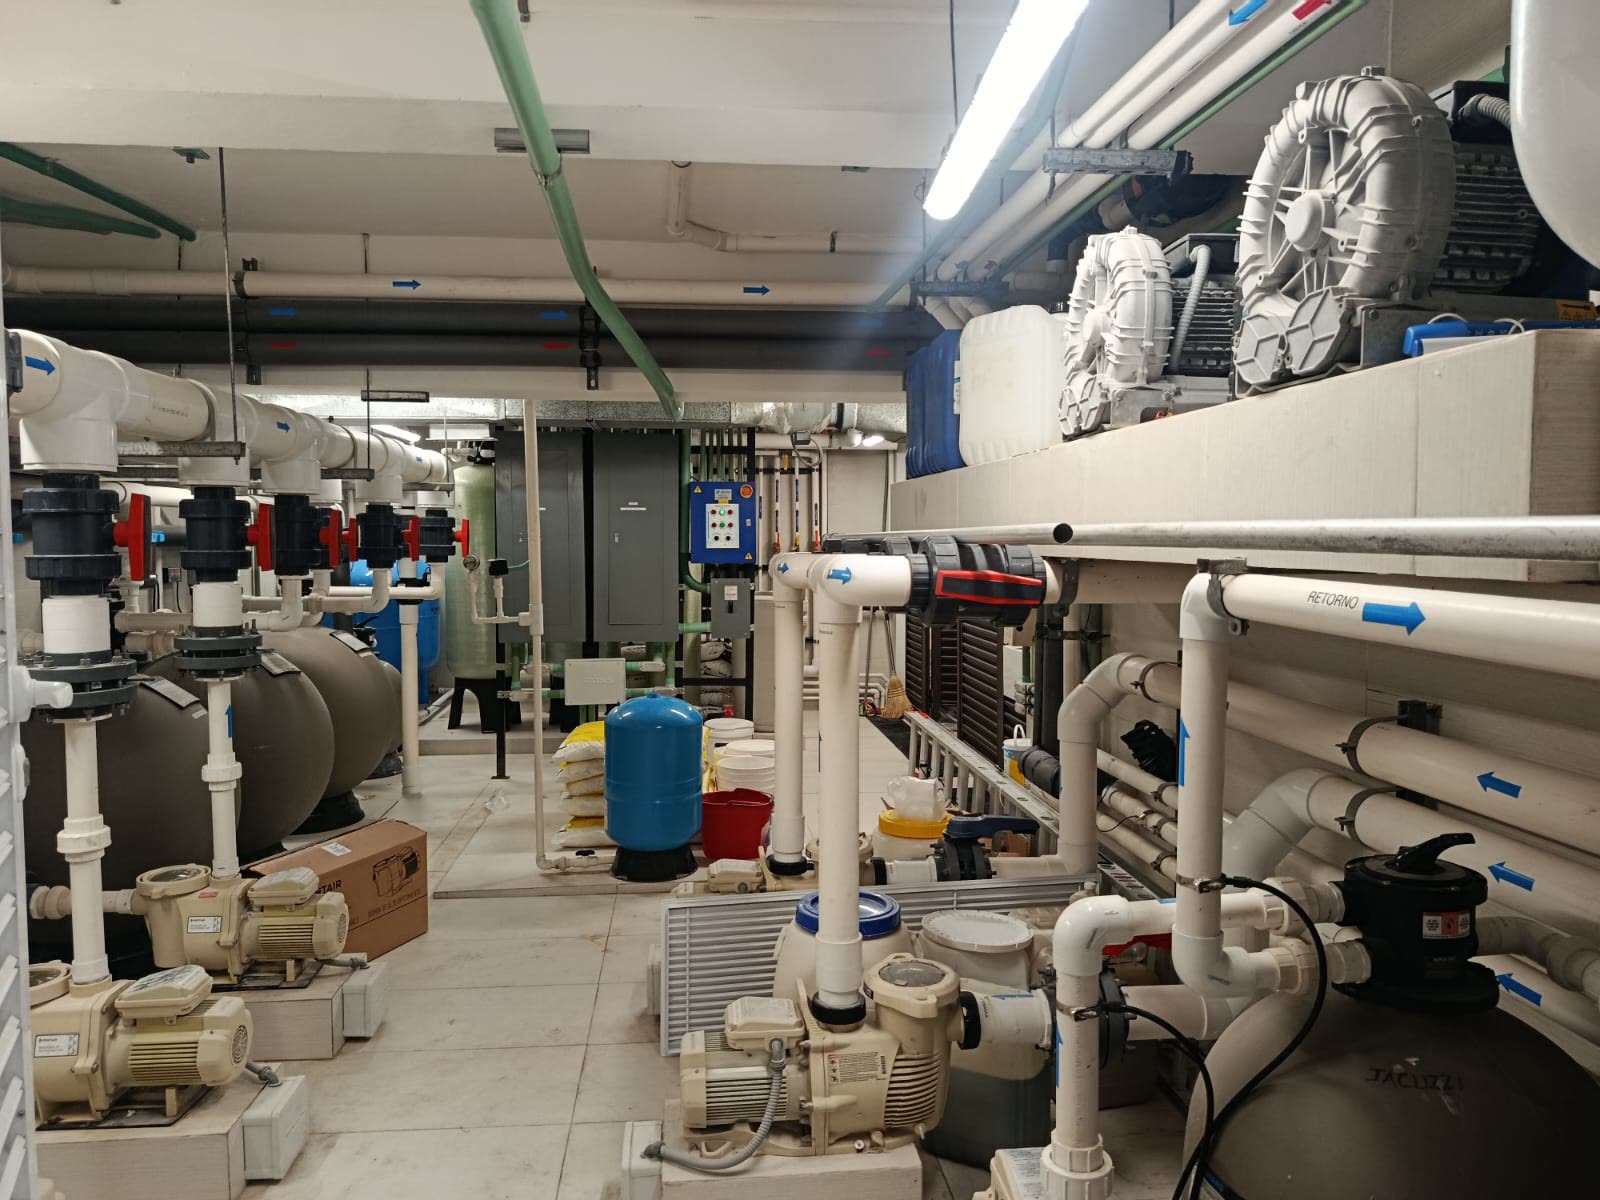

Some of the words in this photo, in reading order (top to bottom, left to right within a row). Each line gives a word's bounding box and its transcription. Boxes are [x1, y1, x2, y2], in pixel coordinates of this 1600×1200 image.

[1307, 591, 1360, 609] RETORNO
[314, 879, 342, 894] NTAIR
[1366, 1068, 1464, 1092] JACUZZI
